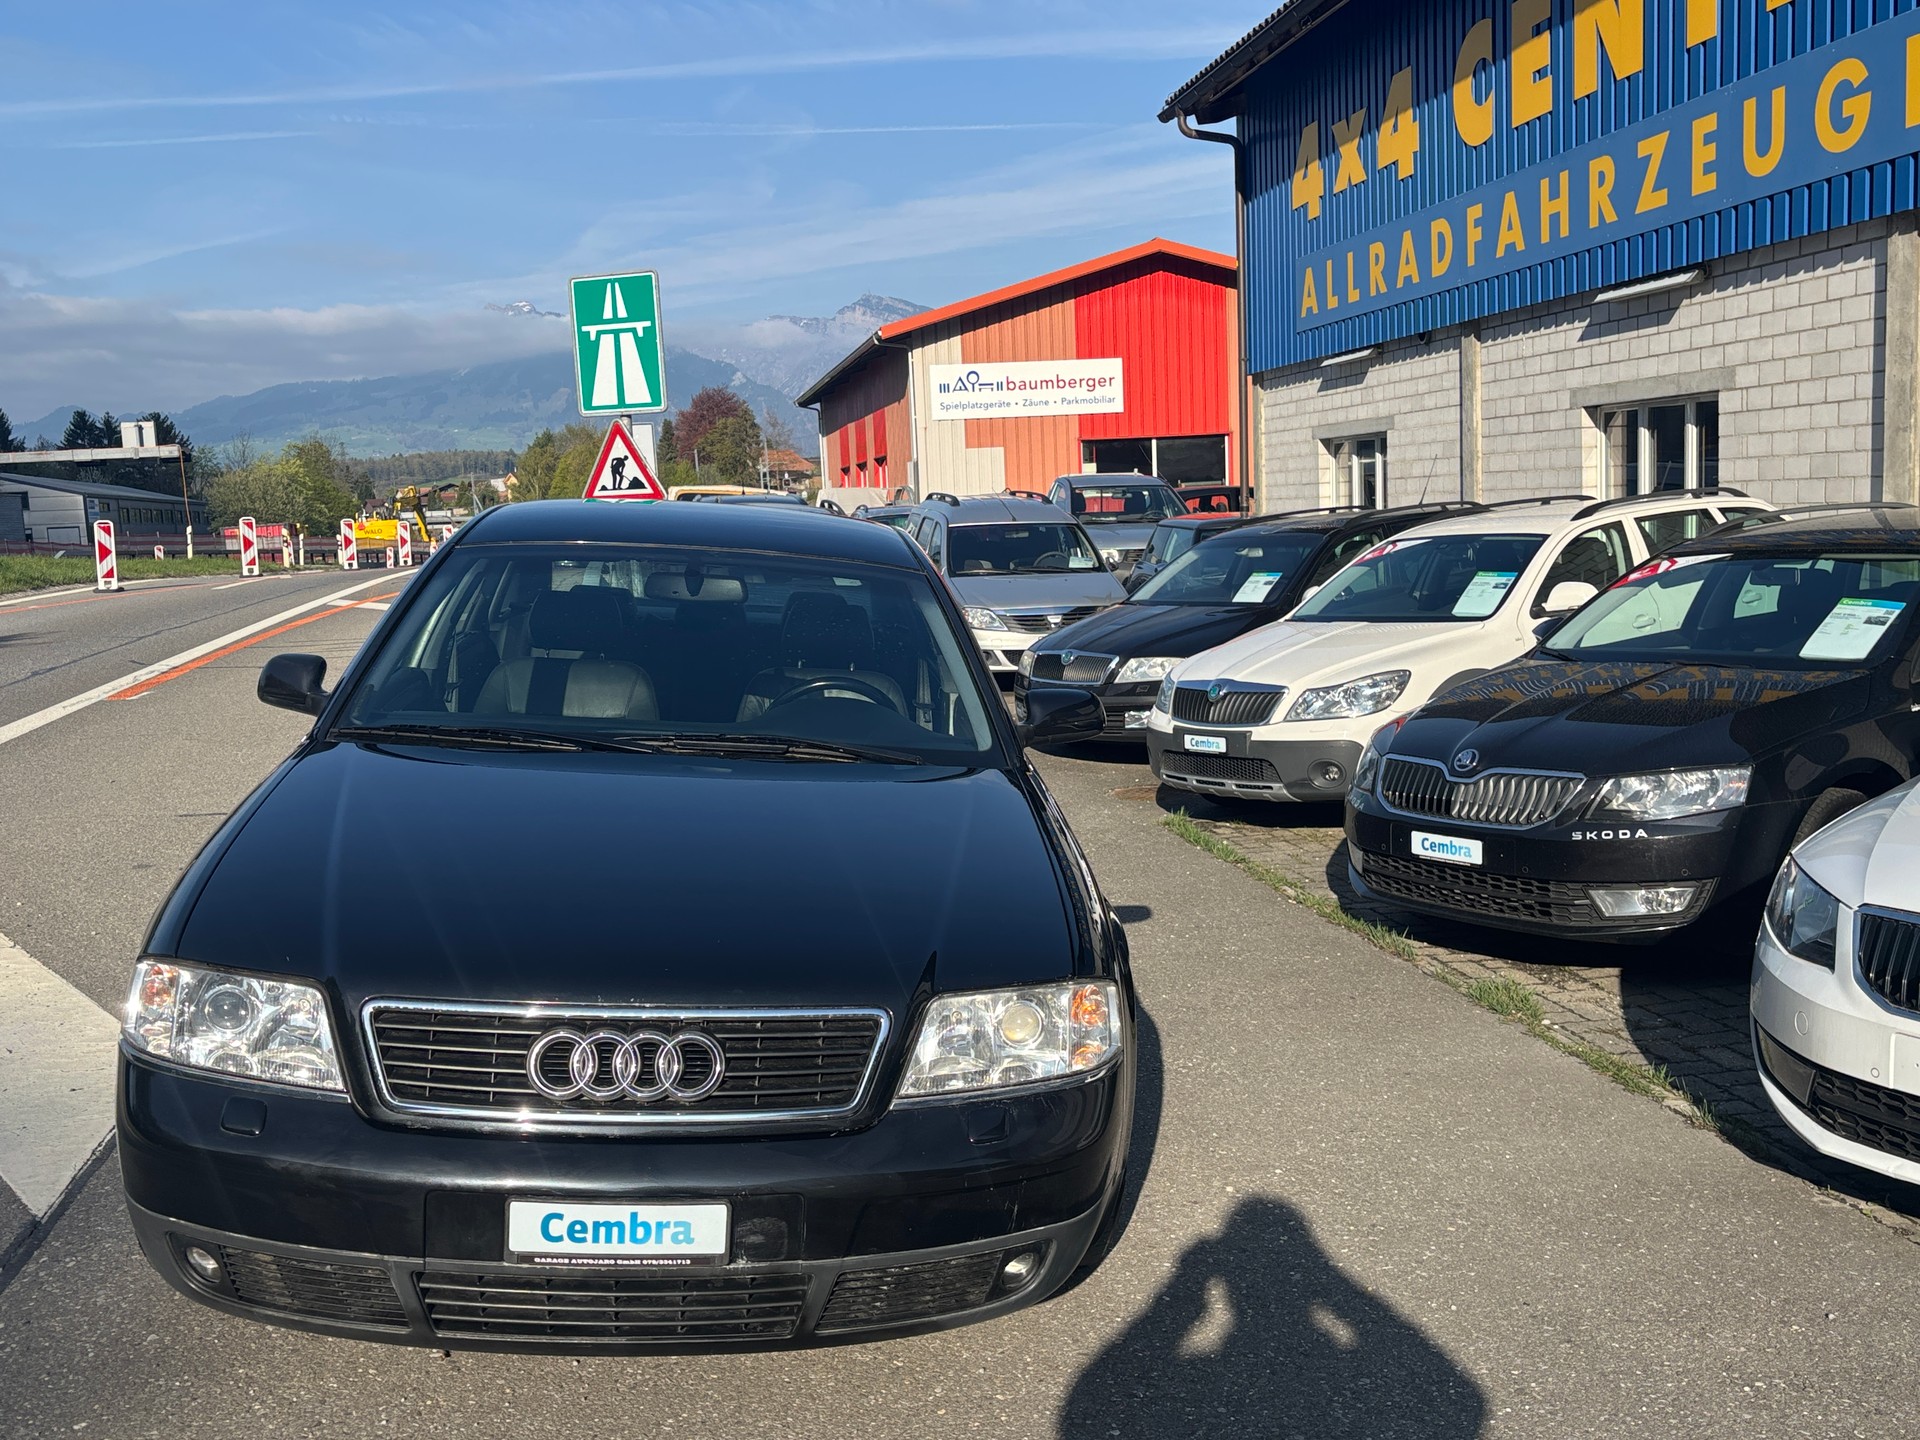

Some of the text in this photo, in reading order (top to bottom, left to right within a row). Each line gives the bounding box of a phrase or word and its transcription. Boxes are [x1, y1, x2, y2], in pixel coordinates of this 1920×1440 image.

[1292, 66, 1419, 220] 4x4
[1006, 374, 1116, 393] baumberger
[940, 396, 1116, 411] Spielplatzgeräte Zäune Parkmobiliar
[1190, 737, 1221, 750] Cembra
[1571, 828, 1649, 841] SKODA
[1421, 837, 1473, 858] Cembra
[540, 1211, 696, 1246] Cembra
